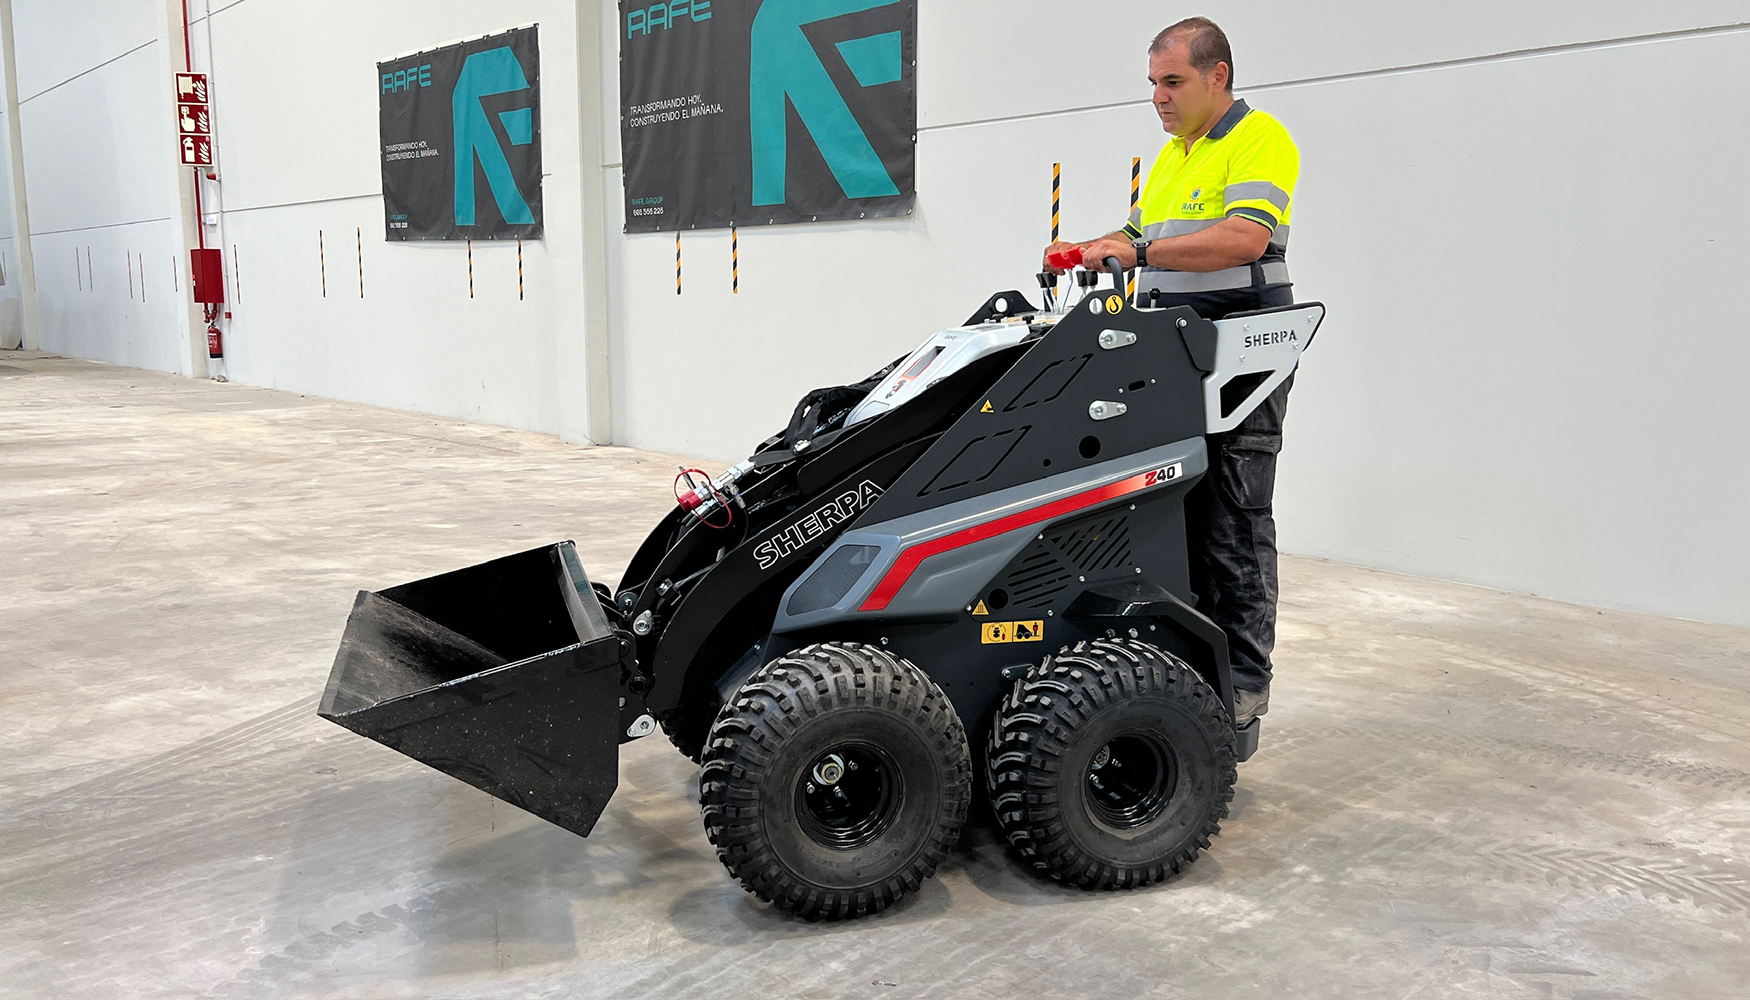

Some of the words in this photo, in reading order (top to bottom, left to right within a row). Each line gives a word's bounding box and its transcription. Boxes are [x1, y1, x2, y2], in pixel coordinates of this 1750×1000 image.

[627, 0, 713, 38] RAFE
[382, 64, 432, 94] RAFE
[629, 110, 680, 128] CONSTRUYENDO
[682, 109, 690, 119] EL
[691, 103, 724, 117] MAÑANA.
[630, 97, 686, 115] TRANSFORMANDO
[687, 94, 702, 105] HOY.
[1244, 329, 1298, 348] SHERPA
[1144, 465, 1176, 487] Z40
[753, 479, 885, 570] SHERPA
